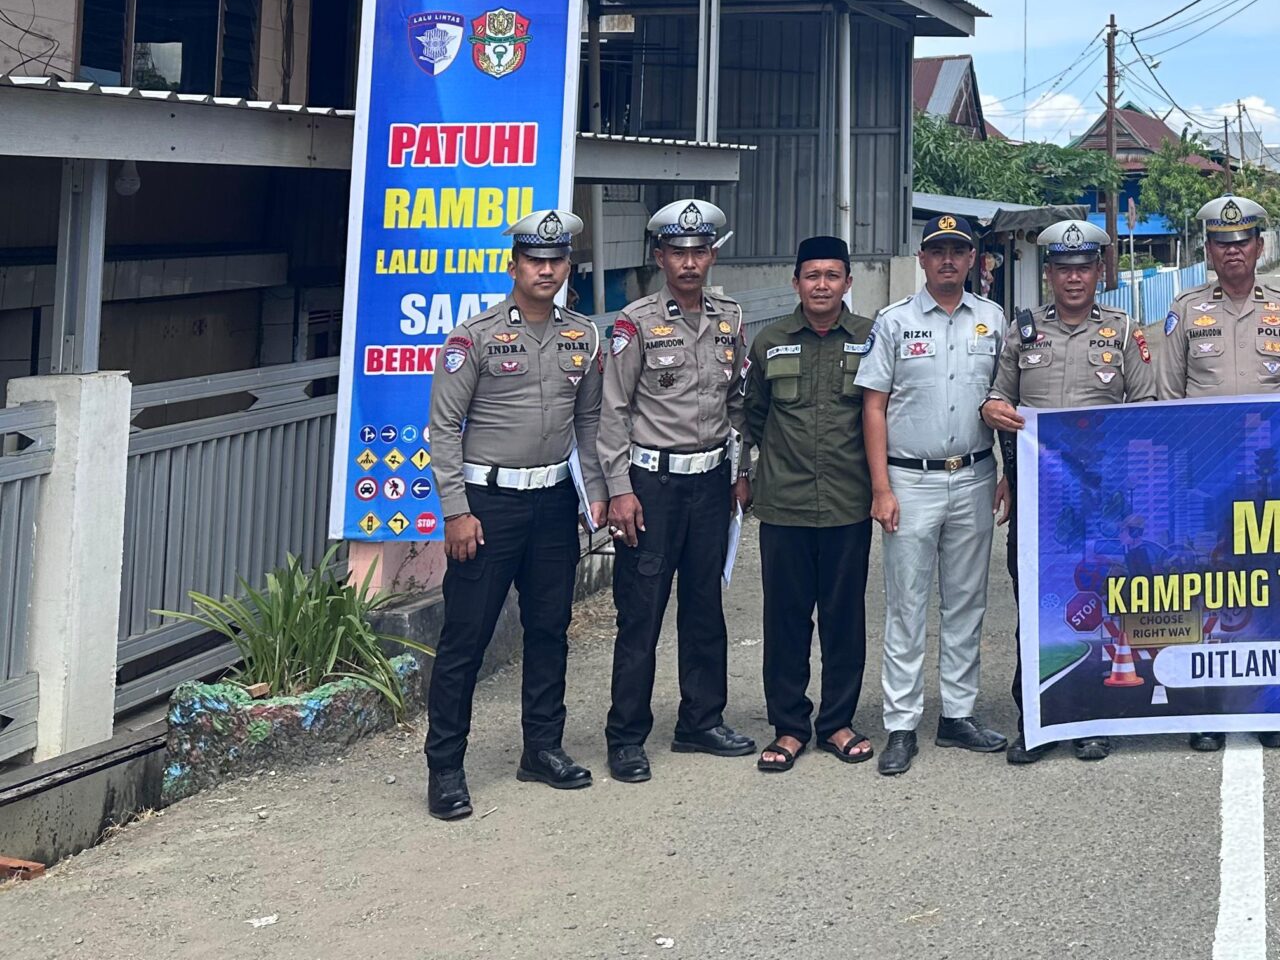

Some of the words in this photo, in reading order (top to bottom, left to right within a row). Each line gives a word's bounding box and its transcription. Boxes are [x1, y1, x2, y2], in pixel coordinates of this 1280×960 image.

[413, 15, 432, 24] LALU
[434, 15, 460, 23] LINTAS
[388, 122, 539, 167] PATUHI
[383, 187, 533, 229] RAMBU
[375, 248, 439, 275] LALU
[444, 248, 513, 274] LINTA
[903, 330, 933, 340] RIZKI
[488, 344, 526, 355] INDRA
[557, 342, 590, 351] POLRI
[645, 338, 685, 350] AMIRUDDIN
[1089, 340, 1124, 350] POLRI
[417, 520, 435, 528] STOP
[1107, 569, 1270, 614] KAMPUNG
[1072, 598, 1096, 626] STOP
[1140, 614, 1184, 625] CHOOSE
[1133, 628, 1166, 638] RIGHT
[1168, 627, 1192, 637] WAY
